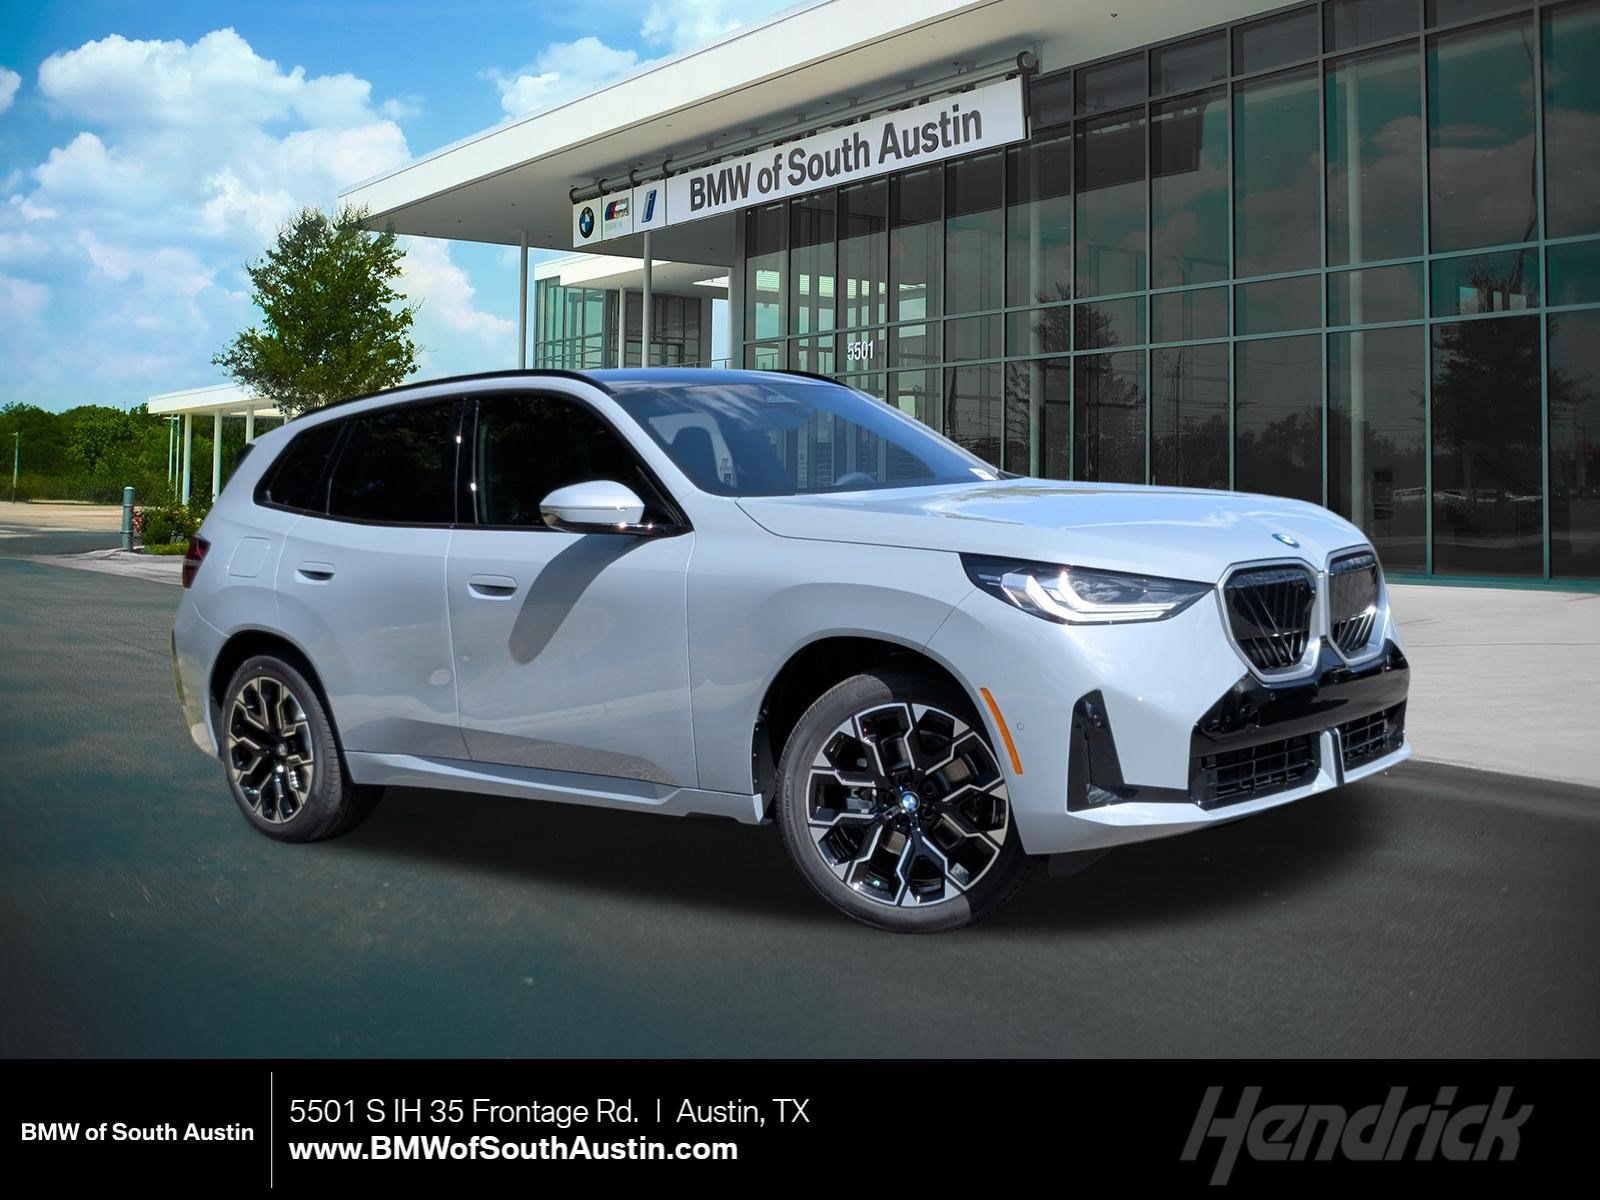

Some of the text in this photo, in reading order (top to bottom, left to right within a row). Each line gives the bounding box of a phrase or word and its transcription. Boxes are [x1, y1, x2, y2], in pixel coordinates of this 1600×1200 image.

[690, 162, 751, 212] BMW
[757, 153, 783, 195] of
[787, 131, 871, 187] South
[878, 104, 983, 165] Austin
[847, 340, 874, 361] 5501
